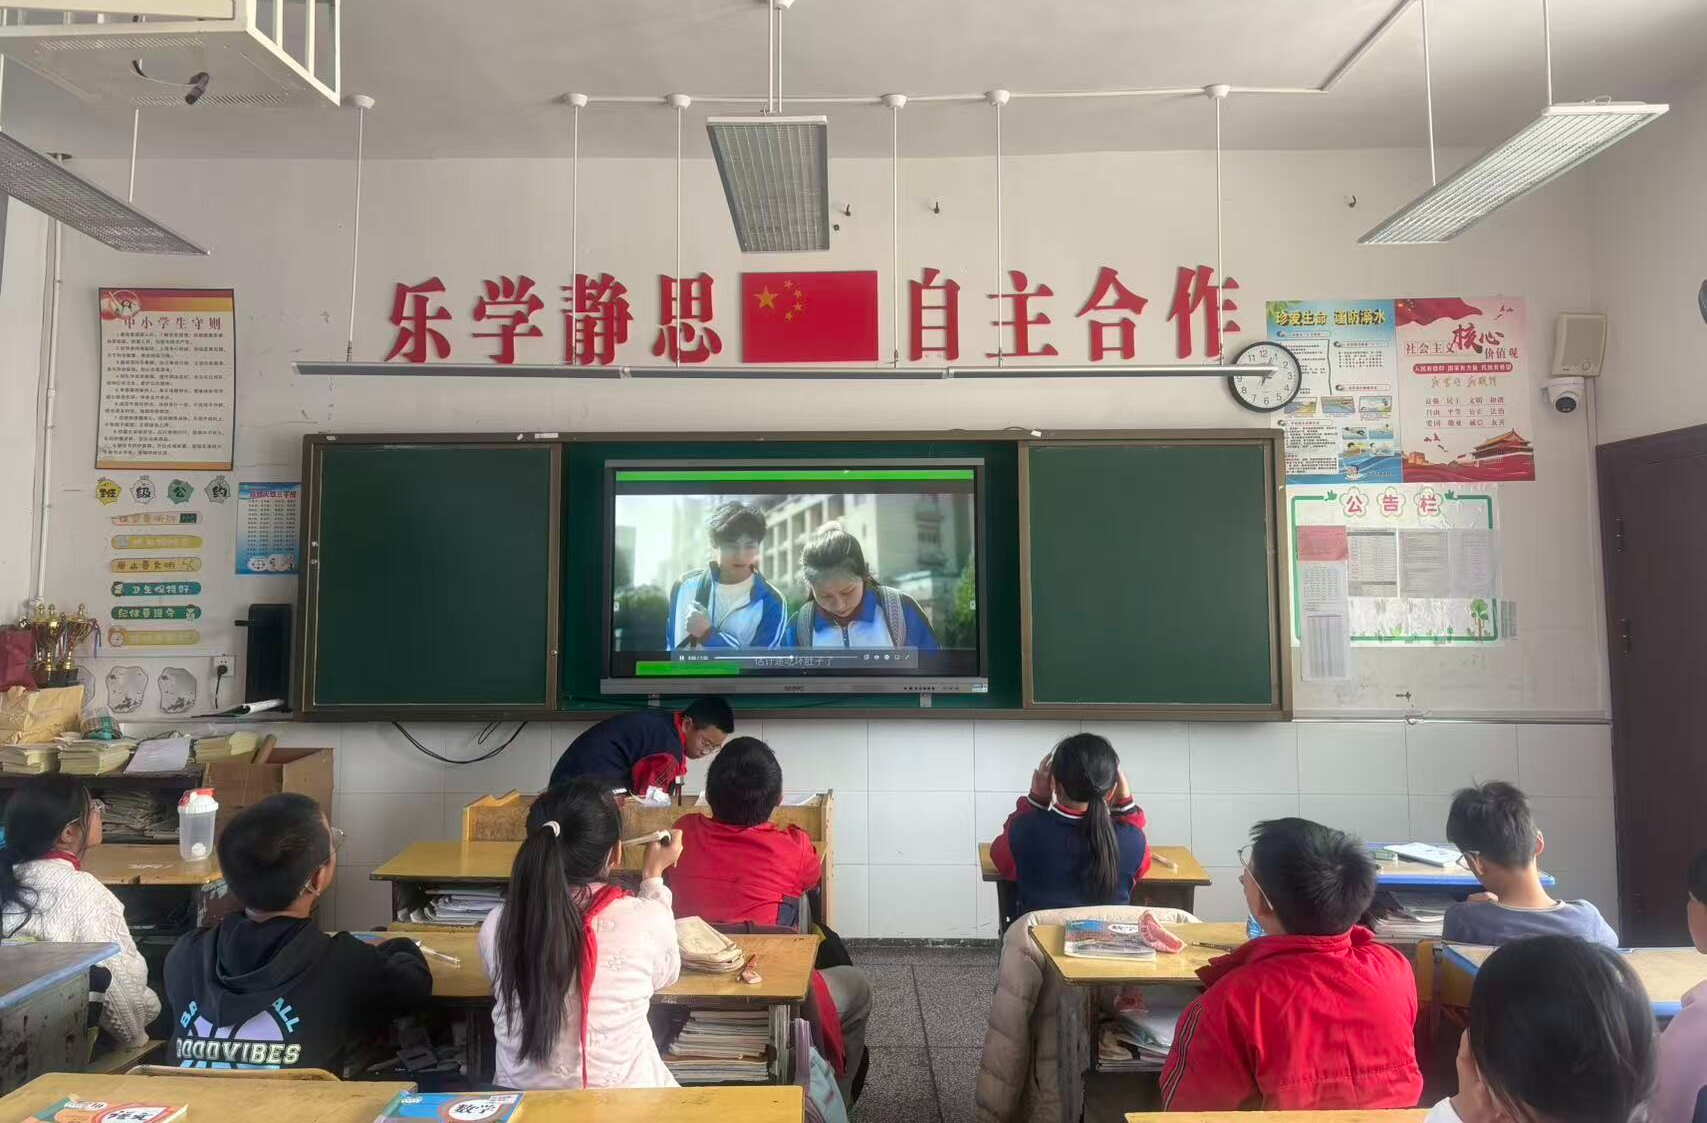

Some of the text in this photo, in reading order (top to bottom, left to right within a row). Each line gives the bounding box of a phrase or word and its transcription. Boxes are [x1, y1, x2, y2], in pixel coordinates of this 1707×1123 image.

[384, 265, 1242, 365] 乐学静思 自主合作
[1276, 309, 1385, 326] 珍爱生命 谨防溺水
[123, 316, 221, 330] 中小学生守则
[1406, 322, 1519, 360] 社会主义 核心 价值观
[1415, 363, 1512, 373] 人民有信仰 国家有力量 民族有希望
[99, 486, 228, 499] 班级公约
[1346, 495, 1438, 513] 公告栏
[118, 560, 176, 570] 举止要文明
[132, 585, 189, 594] 卫生保持好
[118, 608, 175, 617] 纪律要遵守
[456, 1101, 497, 1114] 数学
[107, 1110, 149, 1121] 语文
